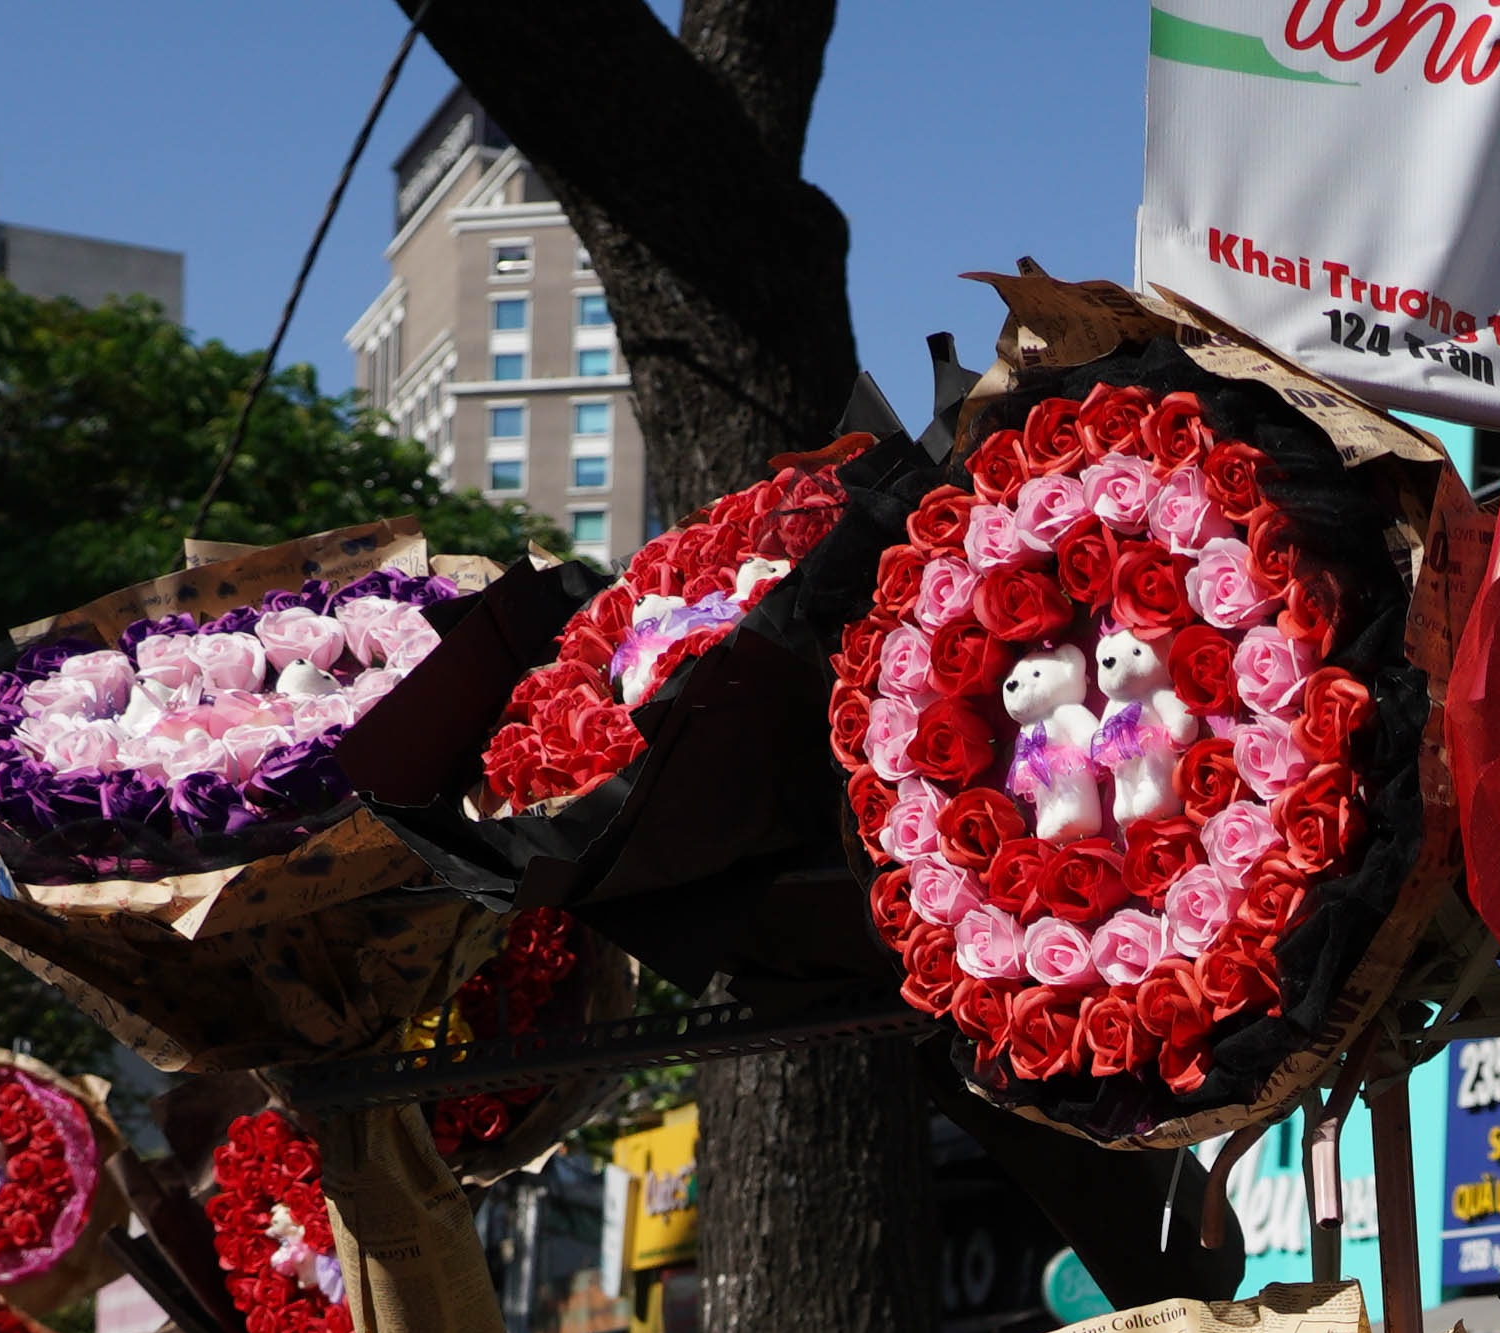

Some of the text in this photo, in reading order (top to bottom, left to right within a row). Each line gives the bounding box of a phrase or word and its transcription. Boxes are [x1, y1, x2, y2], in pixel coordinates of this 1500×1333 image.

[1209, 228, 1310, 290] Khai
[1322, 308, 1392, 358] 124
[1112, 1304, 1188, 1332] Collection
